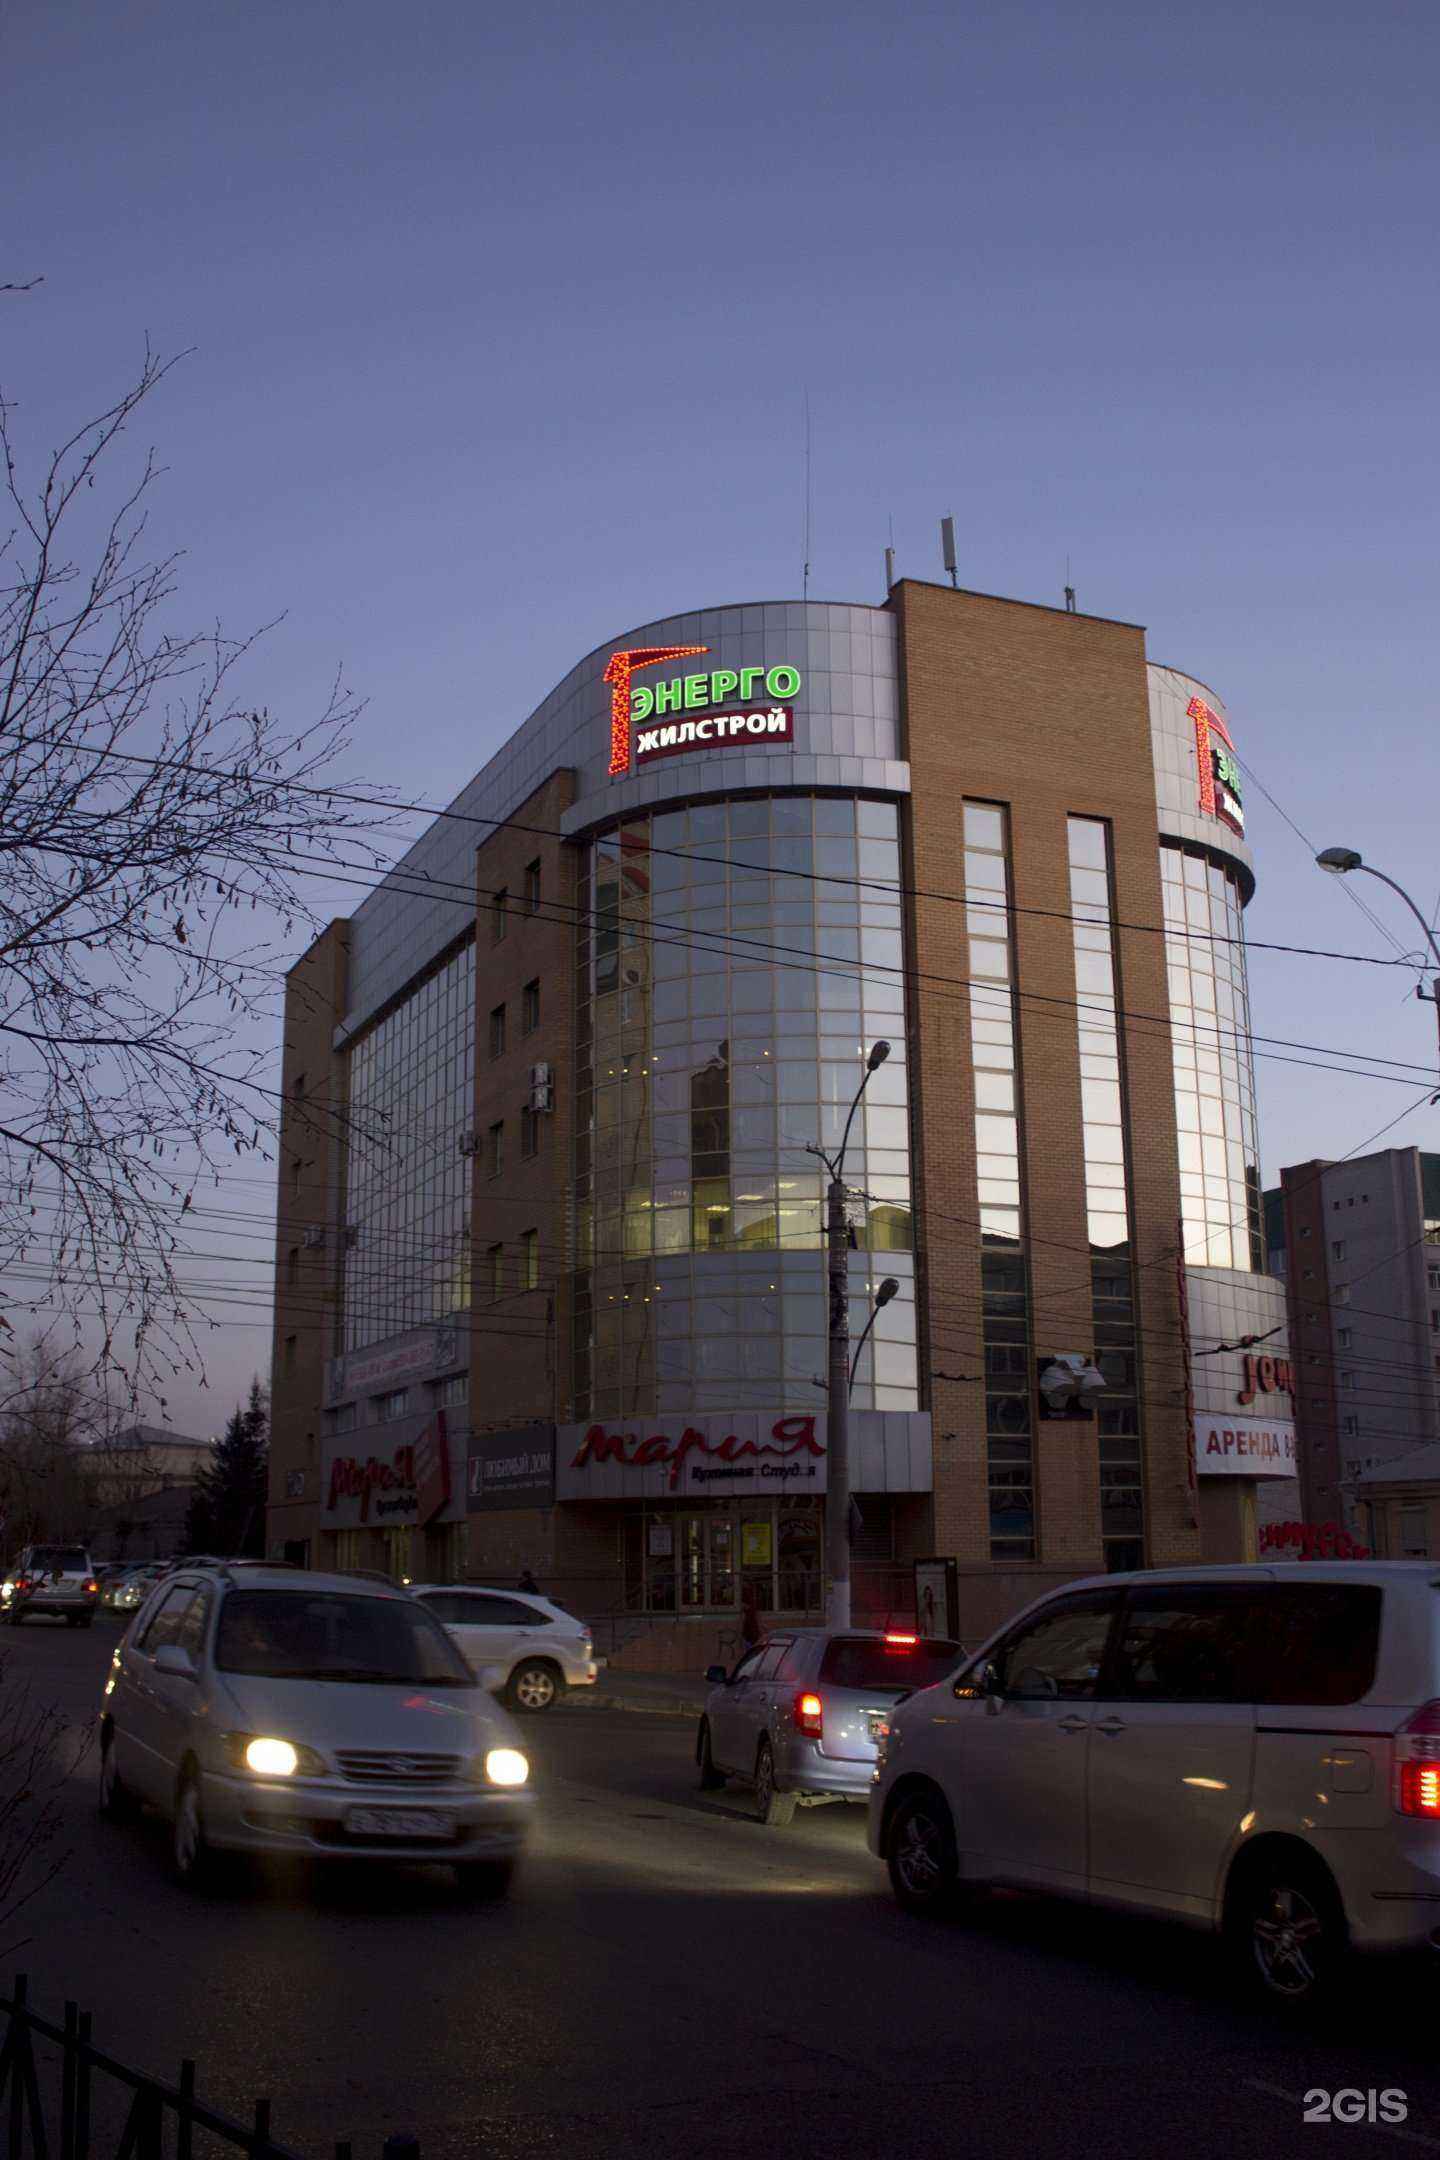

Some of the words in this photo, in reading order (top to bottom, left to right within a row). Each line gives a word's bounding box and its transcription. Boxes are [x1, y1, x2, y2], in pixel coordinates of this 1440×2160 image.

[630, 665, 801, 722] ЭНЕРГО
[636, 706, 787, 754] ЖИЛСТРОЙ
[1206, 1429, 1281, 1462] АРЕНДА
[761, 1462, 816, 1481] Студя
